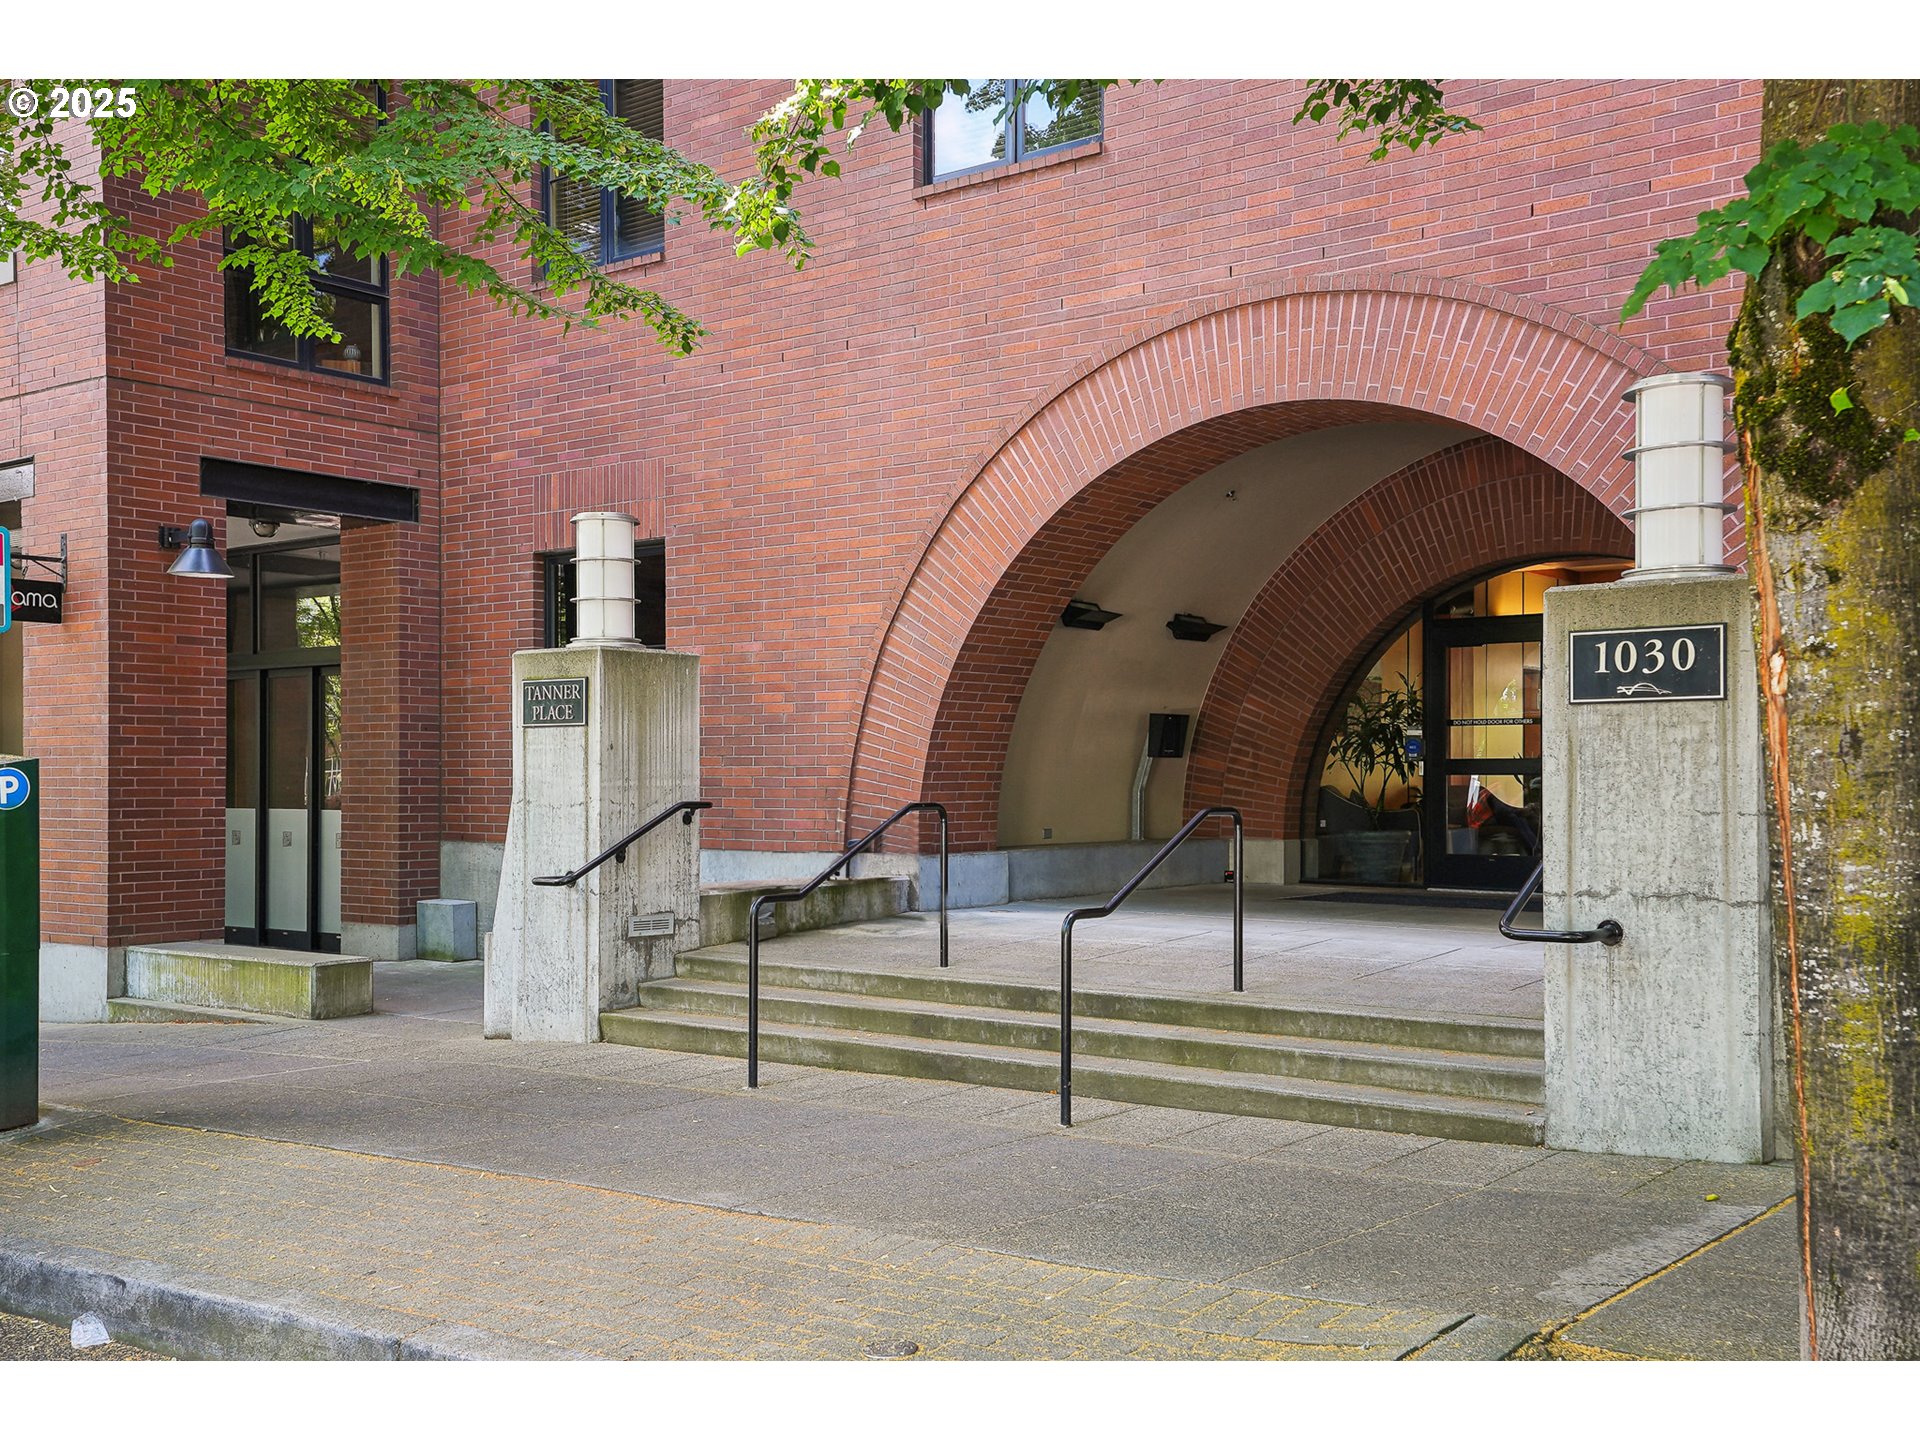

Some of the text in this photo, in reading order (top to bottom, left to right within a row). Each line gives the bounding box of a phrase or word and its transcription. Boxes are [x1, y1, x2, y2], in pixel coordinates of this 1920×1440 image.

[1594, 637, 1696, 674] 1030
[525, 684, 581, 700] TANNER
[532, 704, 574, 720] PLACE
[0, 775, 19, 804] P
